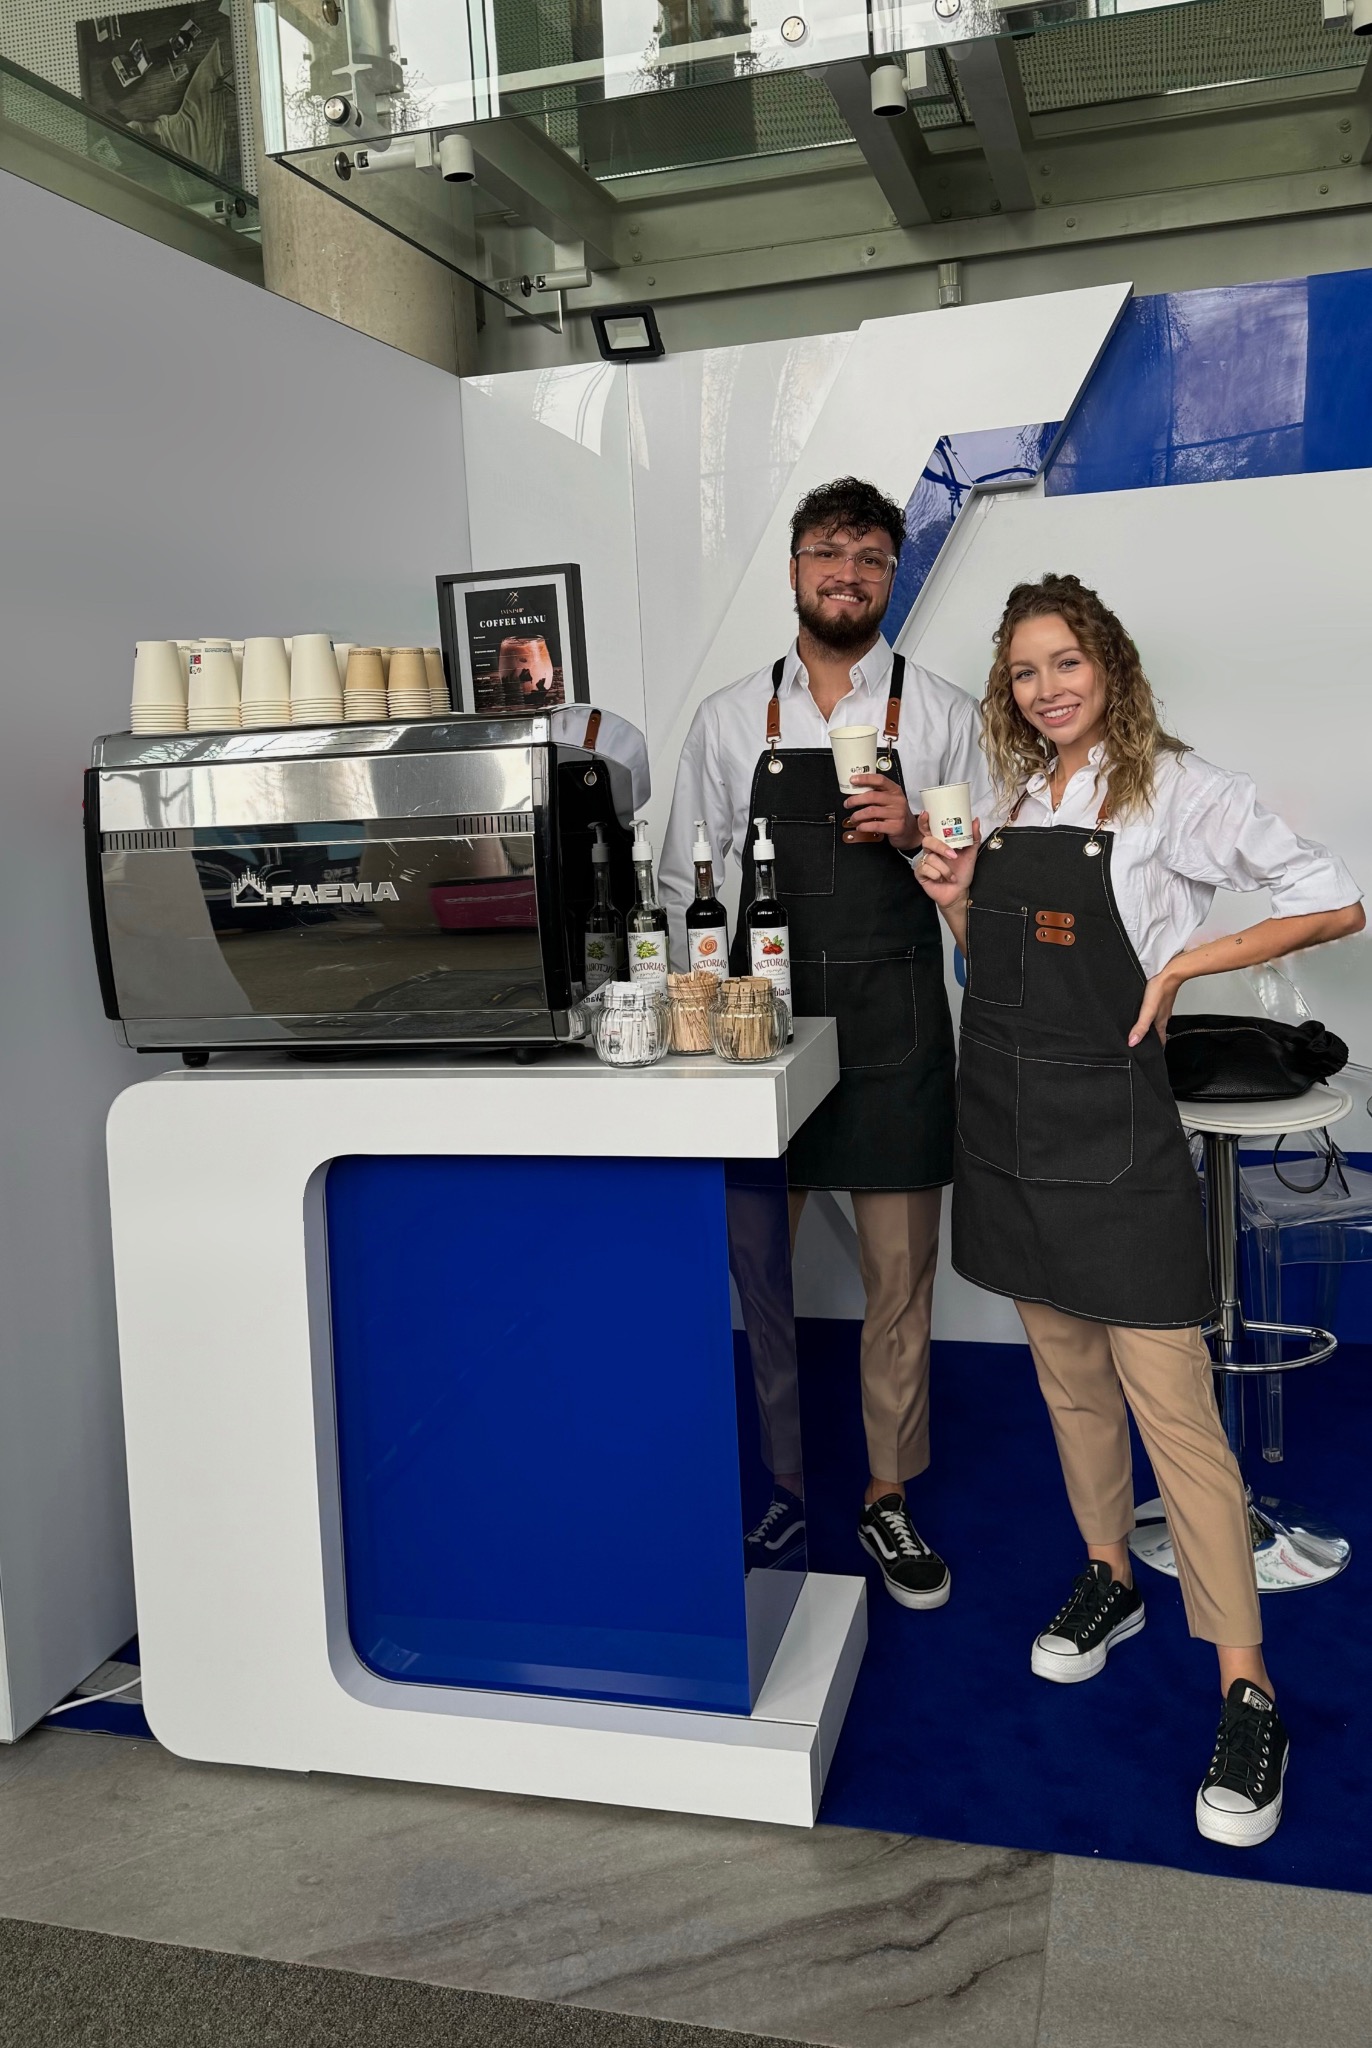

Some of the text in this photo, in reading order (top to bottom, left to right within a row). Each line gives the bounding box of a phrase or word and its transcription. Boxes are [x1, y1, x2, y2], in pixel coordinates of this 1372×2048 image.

[480, 614, 546, 628] COFFEE MENU
[271, 882, 400, 906] FAEMA
[631, 961, 667, 974] VICTORIA'S
[691, 958, 728, 971] VICTORIA'S
[754, 957, 790, 972] VICTORIA'S
